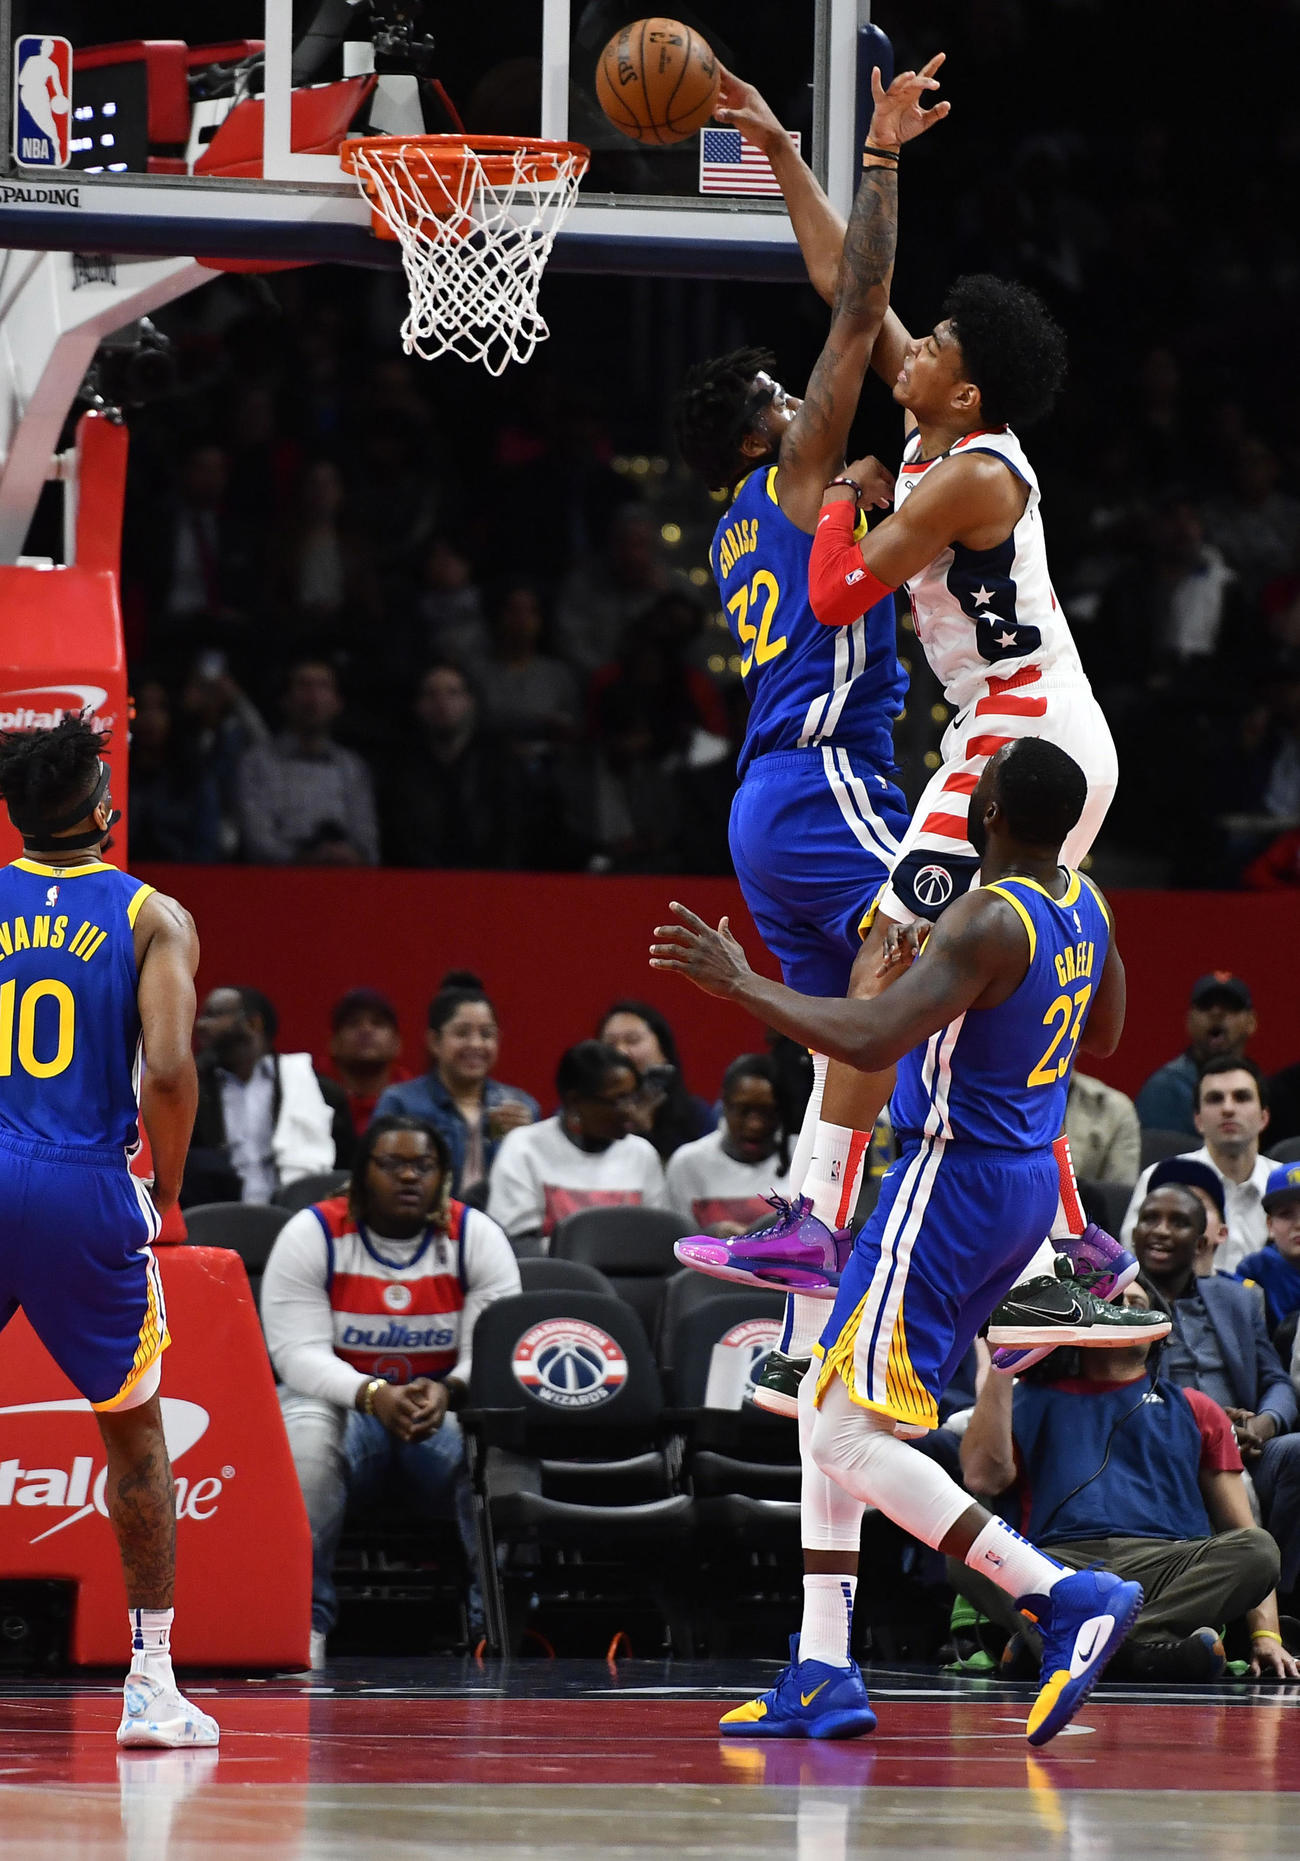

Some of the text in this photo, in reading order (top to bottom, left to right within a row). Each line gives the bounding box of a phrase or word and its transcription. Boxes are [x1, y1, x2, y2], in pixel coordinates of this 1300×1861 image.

[22, 137, 50, 159] NBA
[0, 185, 79, 208] PALDING
[726, 569, 787, 678] 32
[0, 915, 108, 962] VANS III
[0, 978, 75, 1078] 10
[1027, 983, 1092, 1088] 23
[342, 1321, 454, 1348] bullets
[539, 1386, 609, 1407] WIZARDS
